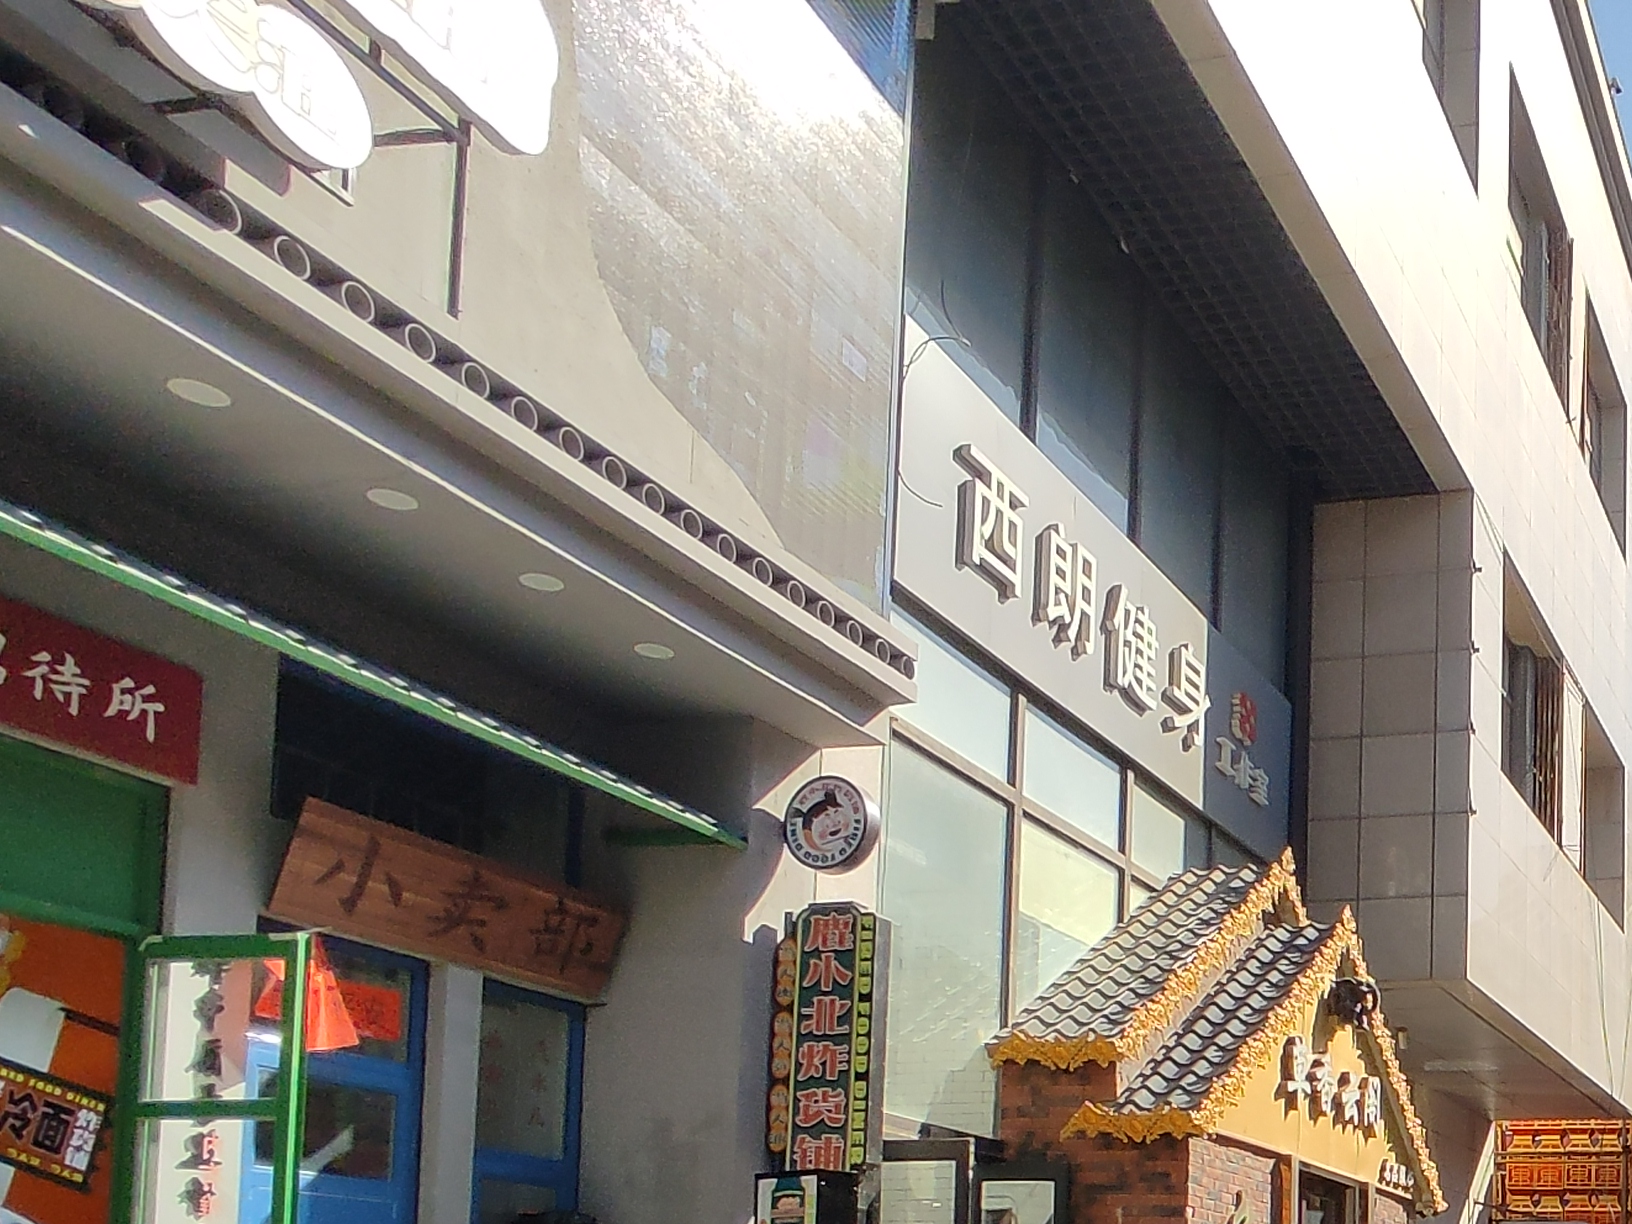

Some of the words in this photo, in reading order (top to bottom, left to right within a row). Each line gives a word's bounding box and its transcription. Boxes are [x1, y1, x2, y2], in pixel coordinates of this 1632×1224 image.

[952, 443, 1211, 752] 西朗健身
[314, 837, 600, 974] 小卖部
[855, 1001, 871, 1073] FOOD
